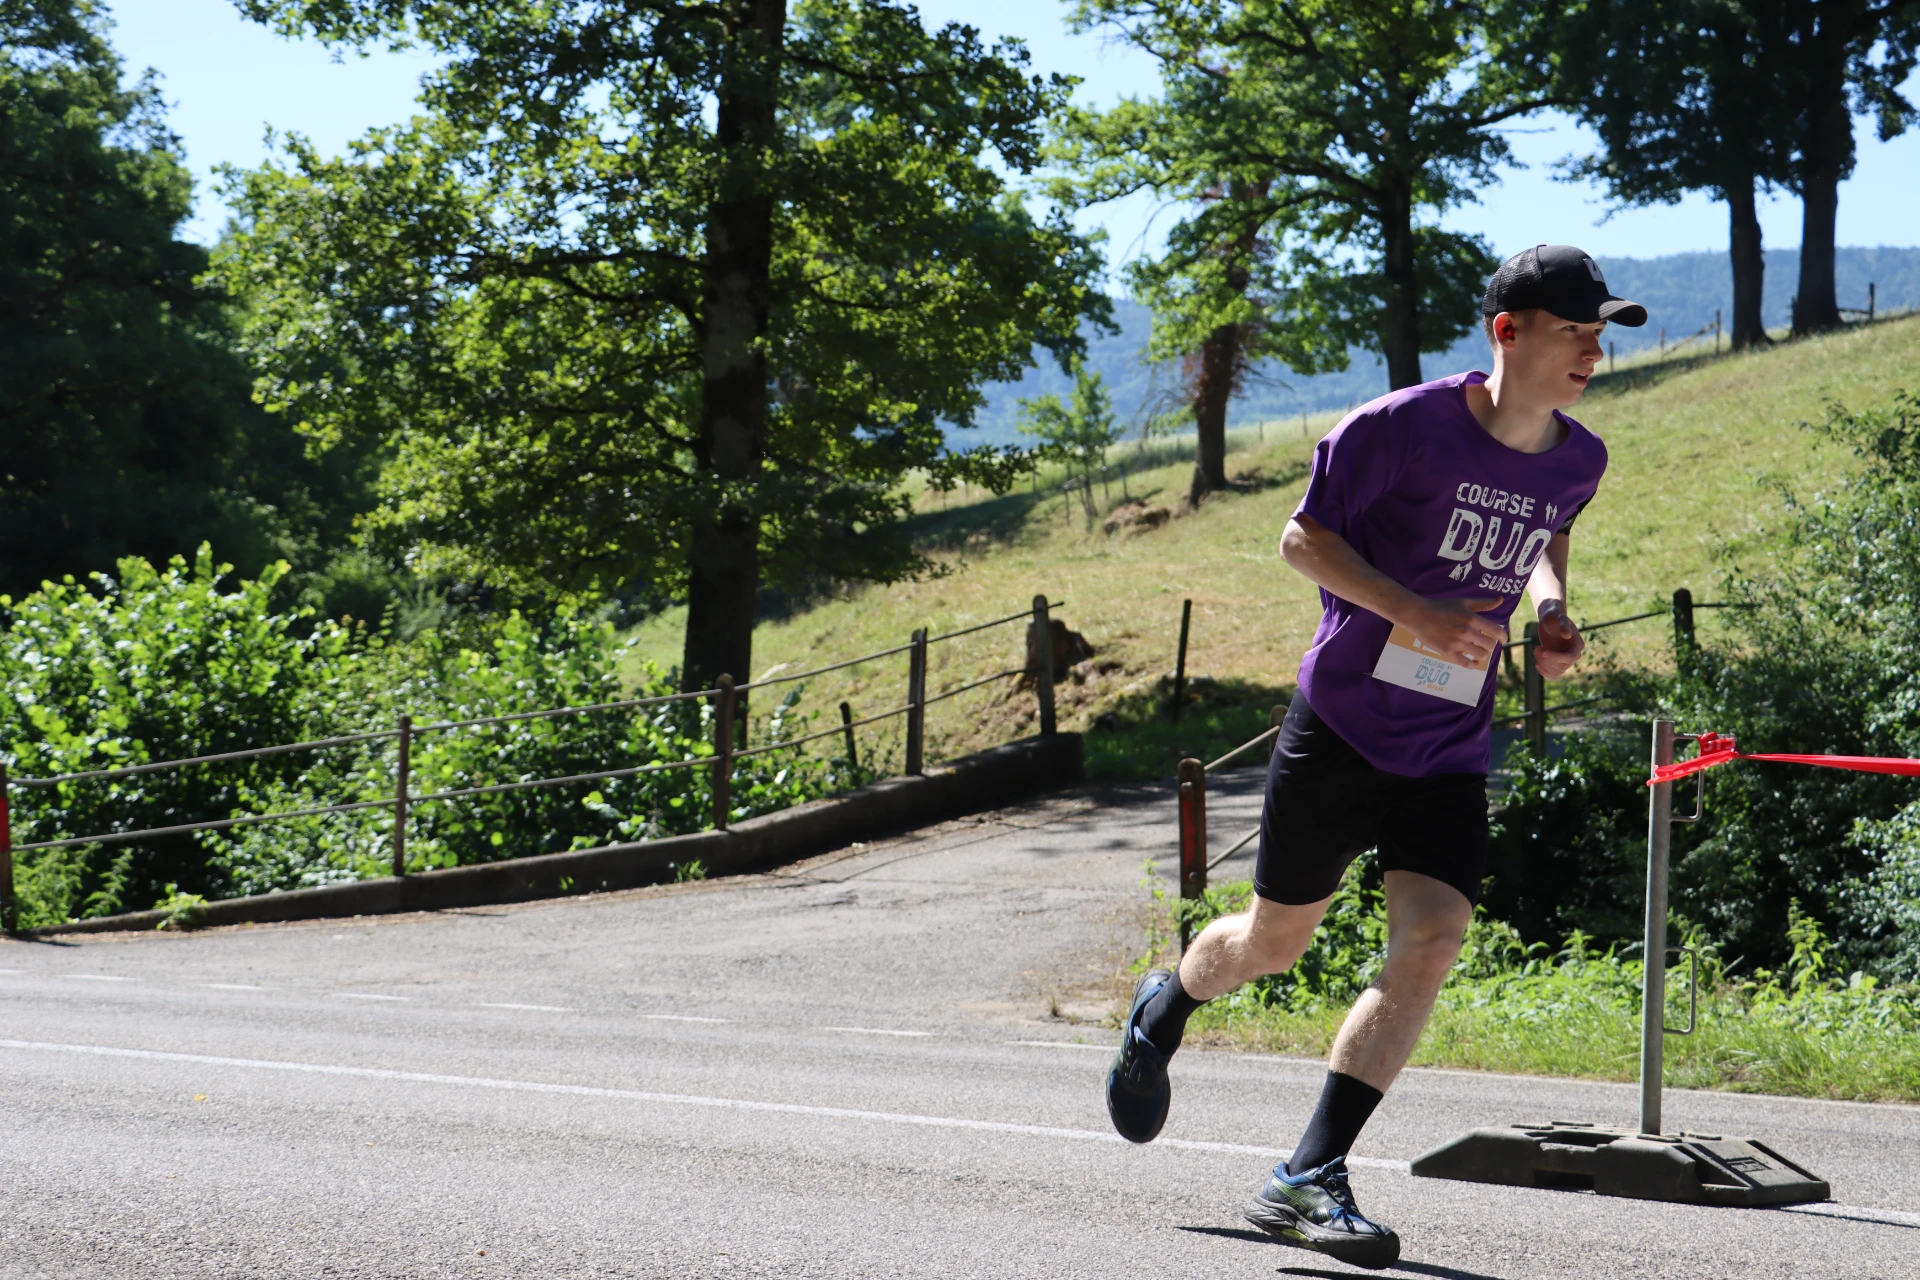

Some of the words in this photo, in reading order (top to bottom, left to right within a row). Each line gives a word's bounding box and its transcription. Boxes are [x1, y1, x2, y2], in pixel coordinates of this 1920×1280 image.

[1456, 482, 1536, 518] COURSE
[1437, 507, 1551, 576] DUO
[1415, 664, 1451, 686] DUO
[1421, 657, 1446, 670] COURSE
